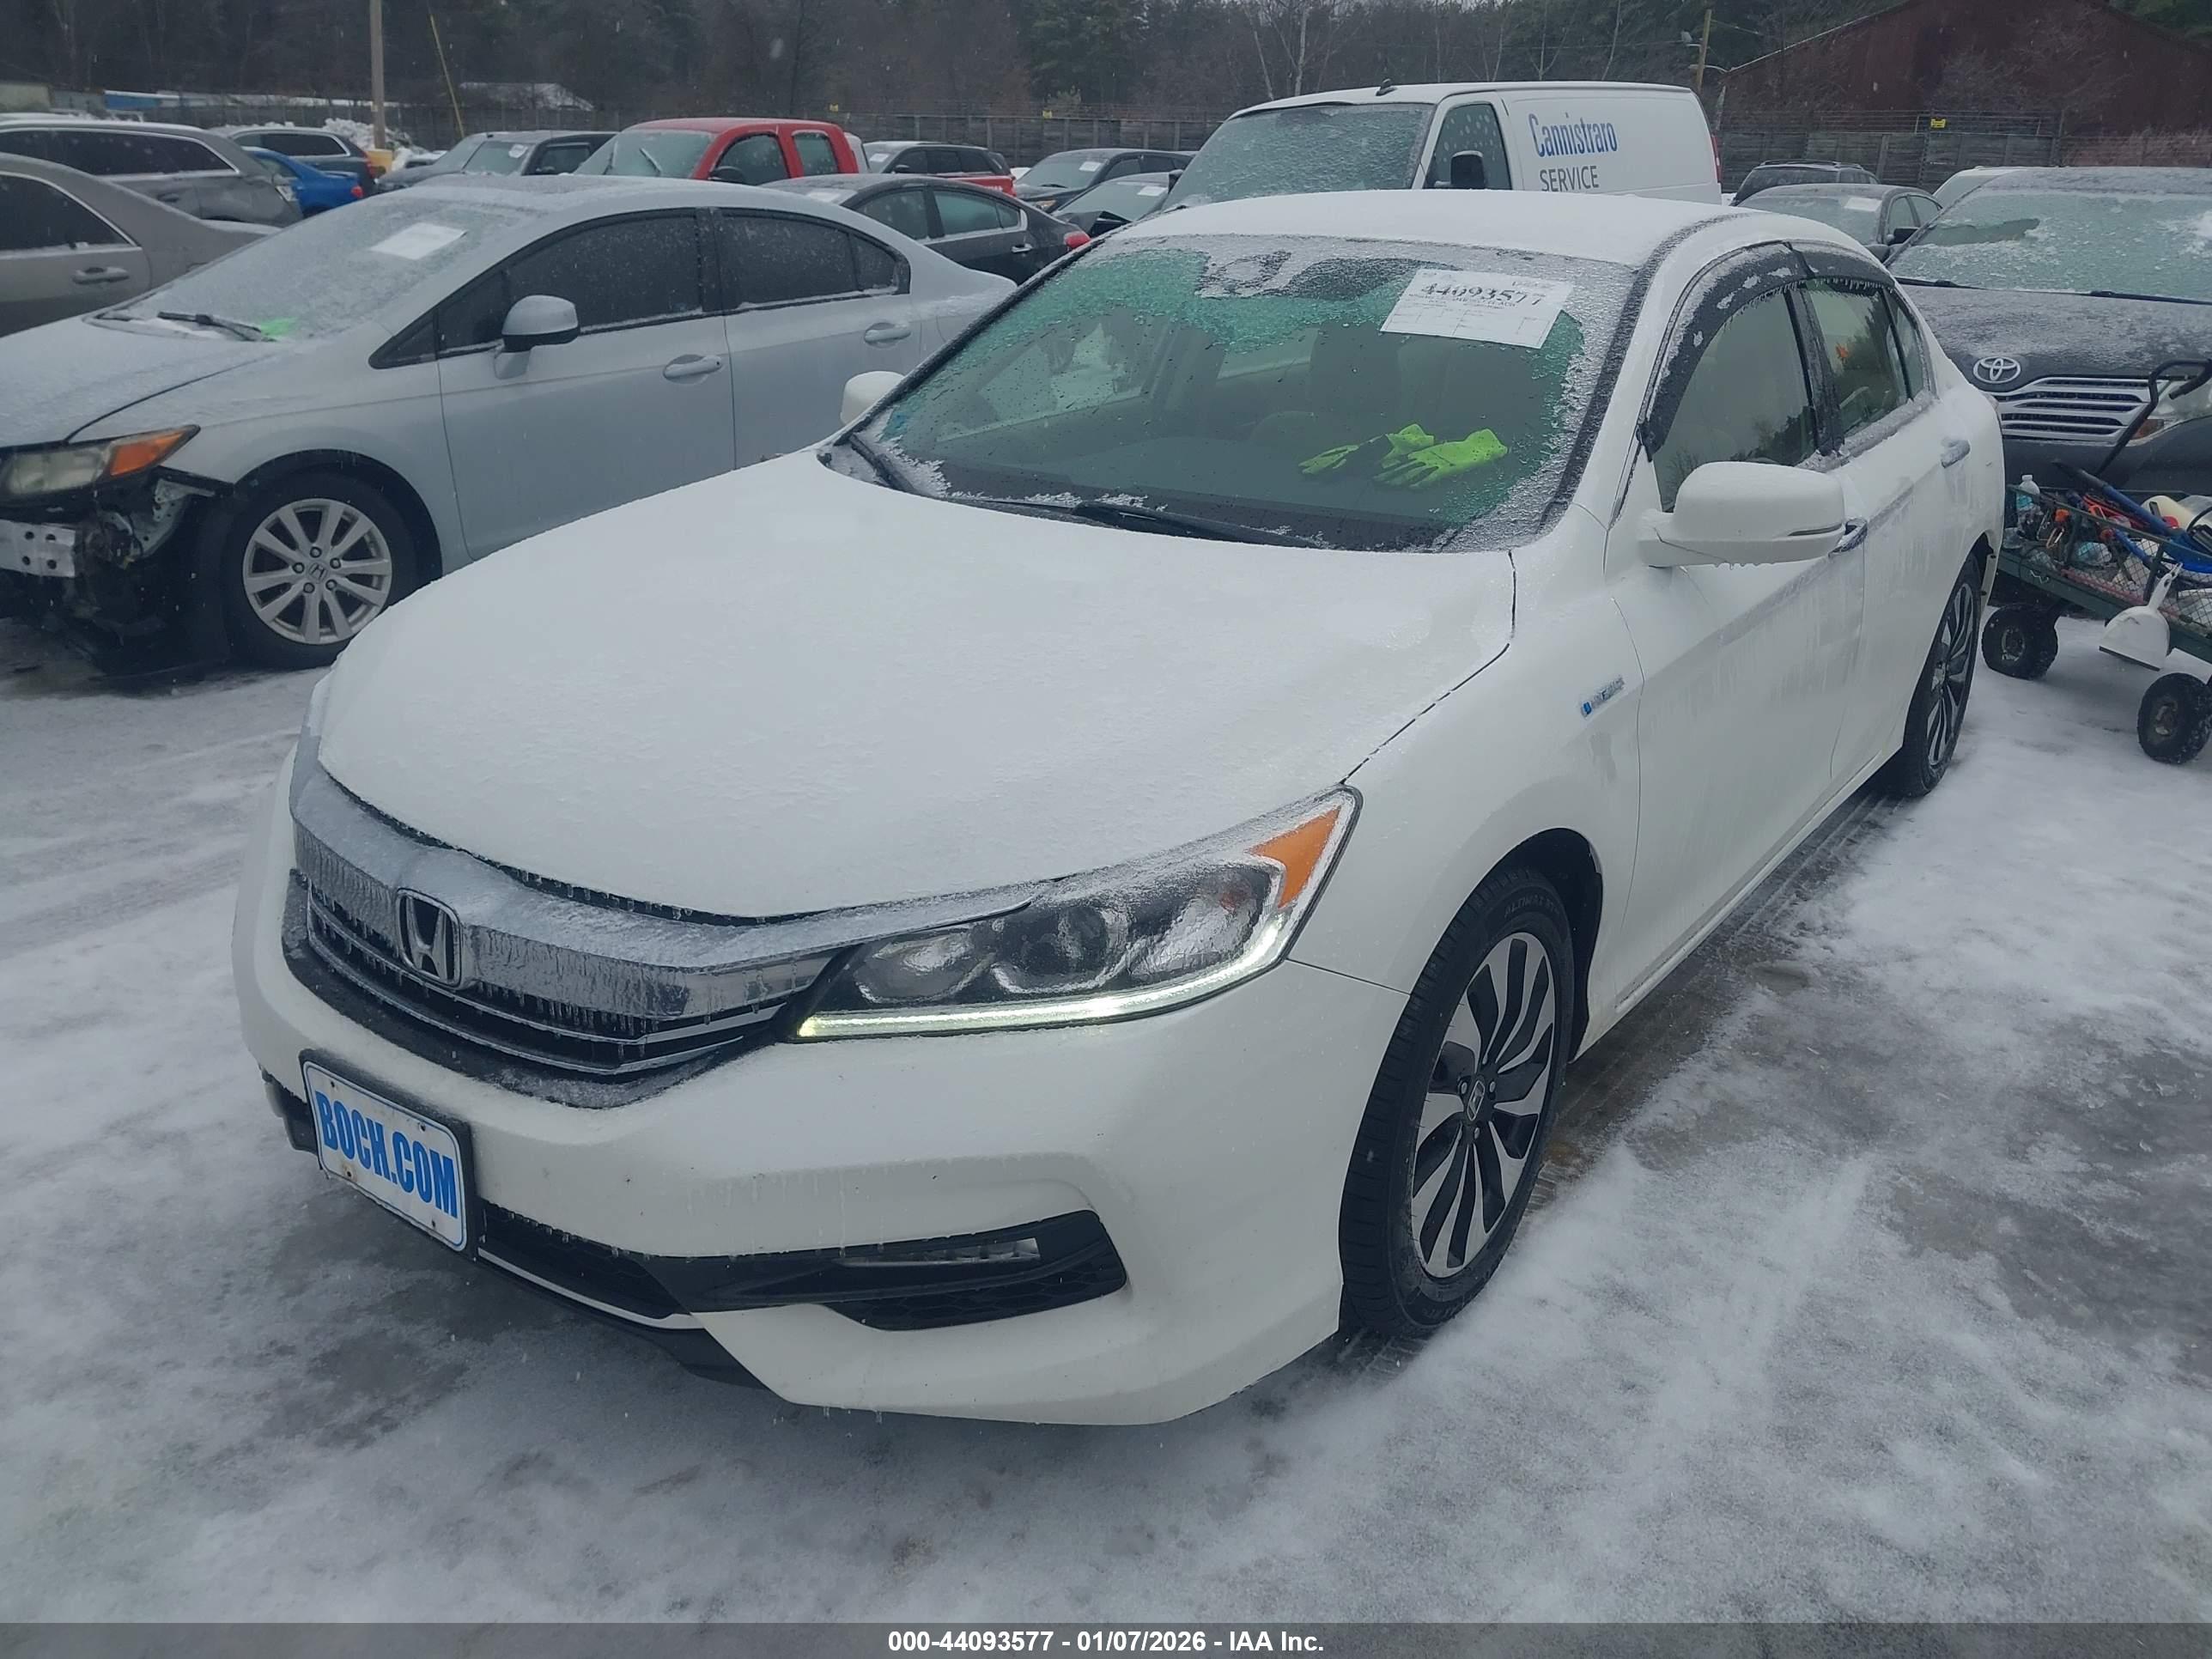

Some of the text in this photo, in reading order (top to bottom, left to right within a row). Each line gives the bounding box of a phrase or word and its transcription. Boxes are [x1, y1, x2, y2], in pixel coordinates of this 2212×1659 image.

[1528, 112, 1618, 157] Cannistraro
[1539, 166, 1599, 192] SERVICE
[1421, 283, 1546, 306] 44093577
[315, 1091, 458, 1218] BOCH.COM
